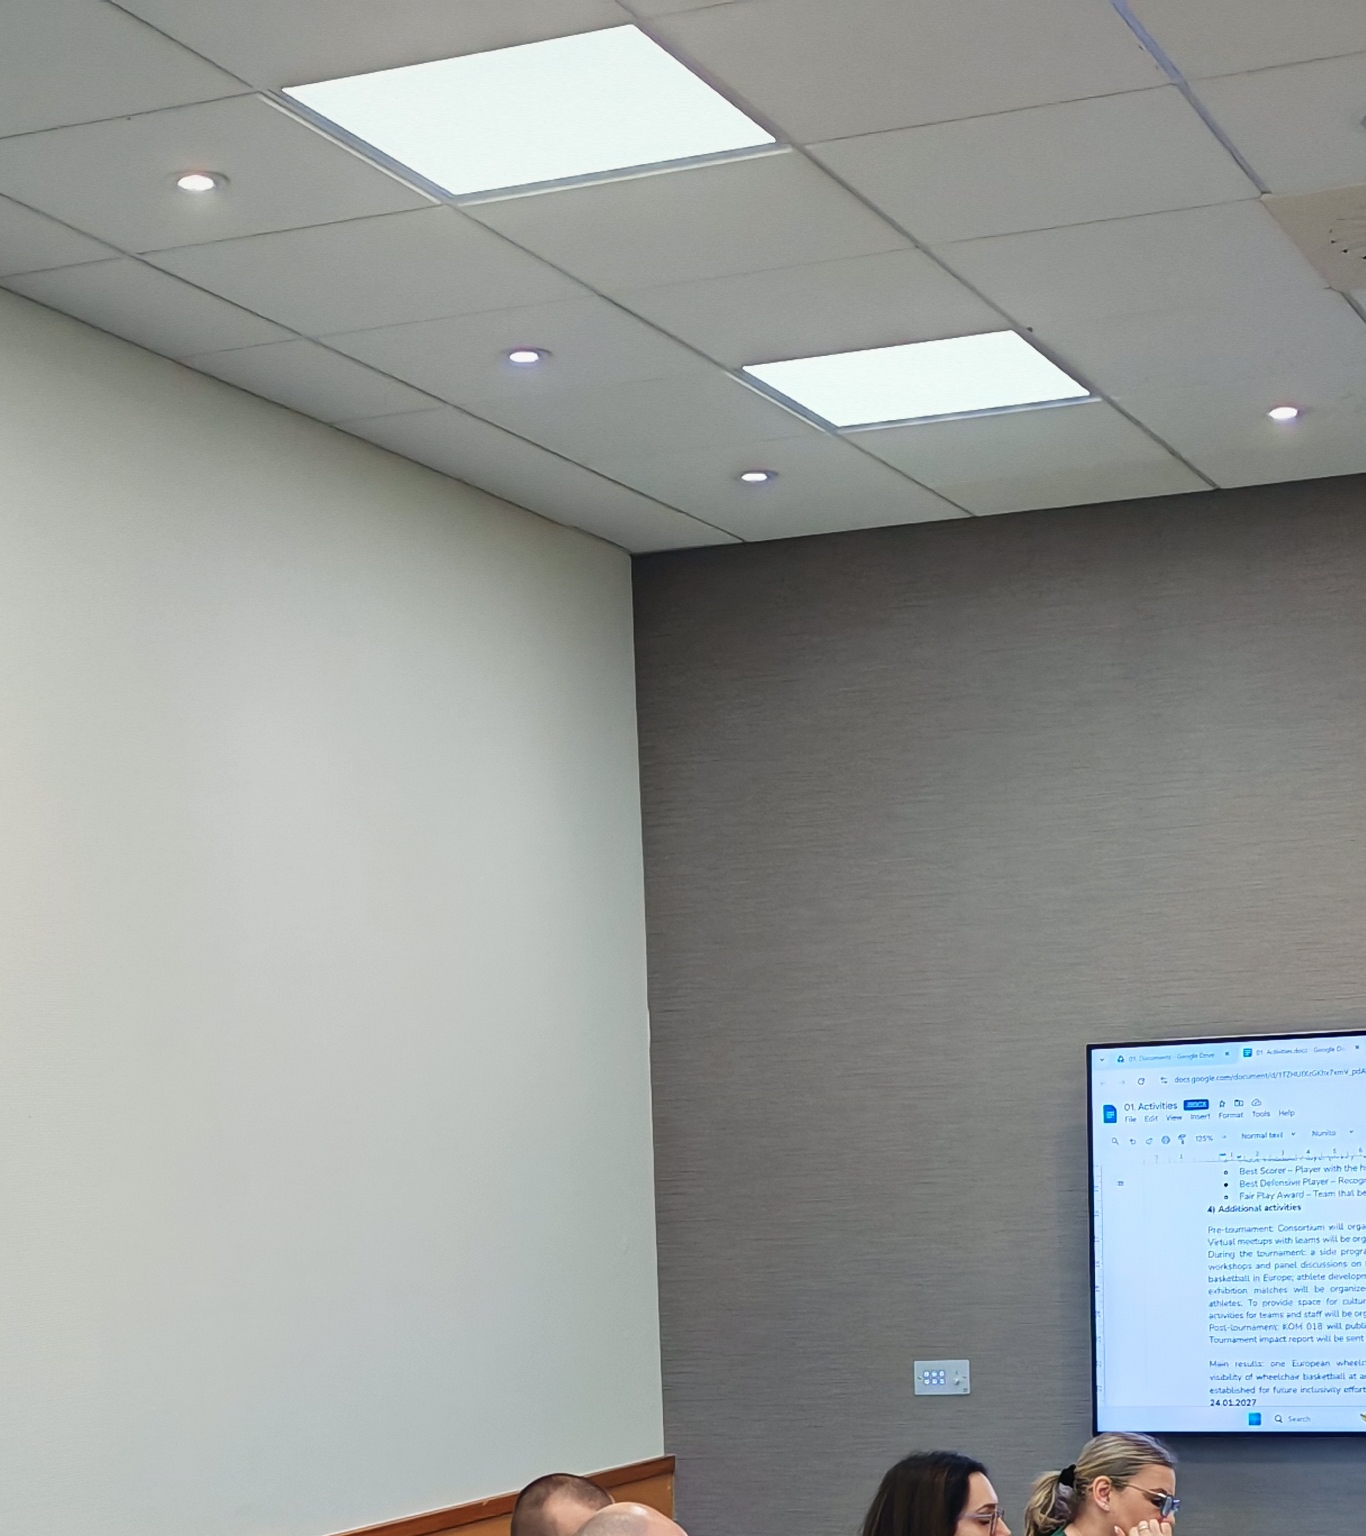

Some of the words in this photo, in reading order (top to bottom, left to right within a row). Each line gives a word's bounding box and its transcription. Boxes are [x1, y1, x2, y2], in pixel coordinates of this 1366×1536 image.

[1138, 1100, 1178, 1111] Activities
[1218, 1110, 1244, 1119] Format
[1252, 1109, 1271, 1118] Tools
[1278, 1108, 1296, 1118] Help
[1239, 1166, 1257, 1175] Best
[1260, 1165, 1285, 1175] Scorer
[1323, 1164, 1341, 1173] with
[1343, 1163, 1357, 1172] the
[1239, 1179, 1258, 1187] Best
[1276, 1190, 1304, 1199] Award
[1314, 1189, 1335, 1198] Team
[1218, 1204, 1261, 1213] Additional
[1264, 1203, 1301, 1212] activities
[1207, 1237, 1235, 1246] Virtual
[1275, 1236, 1293, 1244] with
[1208, 1249, 1235, 1260] During
[1239, 1249, 1252, 1258] the
[1255, 1261, 1271, 1269] and
[1274, 1260, 1297, 1271] panel
[1300, 1259, 1347, 1269] discussions
[1296, 1272, 1325, 1281] athlete
[1262, 1298, 1293, 1308] provide
[1297, 1299, 1320, 1308] space
[1259, 1310, 1283, 1319] teams
[1286, 1310, 1301, 1318] and
[1304, 1309, 1322, 1318] staff
[1282, 1322, 1303, 1331] KOM
[1306, 1322, 1322, 1330] 018
[1209, 1335, 1257, 1343] Tournament
[1259, 1334, 1286, 1345] impact
[1288, 1334, 1313, 1345] report
[1346, 1334, 1363, 1342] sent
[1292, 1358, 1330, 1369] European
[1302, 1372, 1345, 1380] basketball
[1210, 1398, 1256, 1406] 24.01.2027
